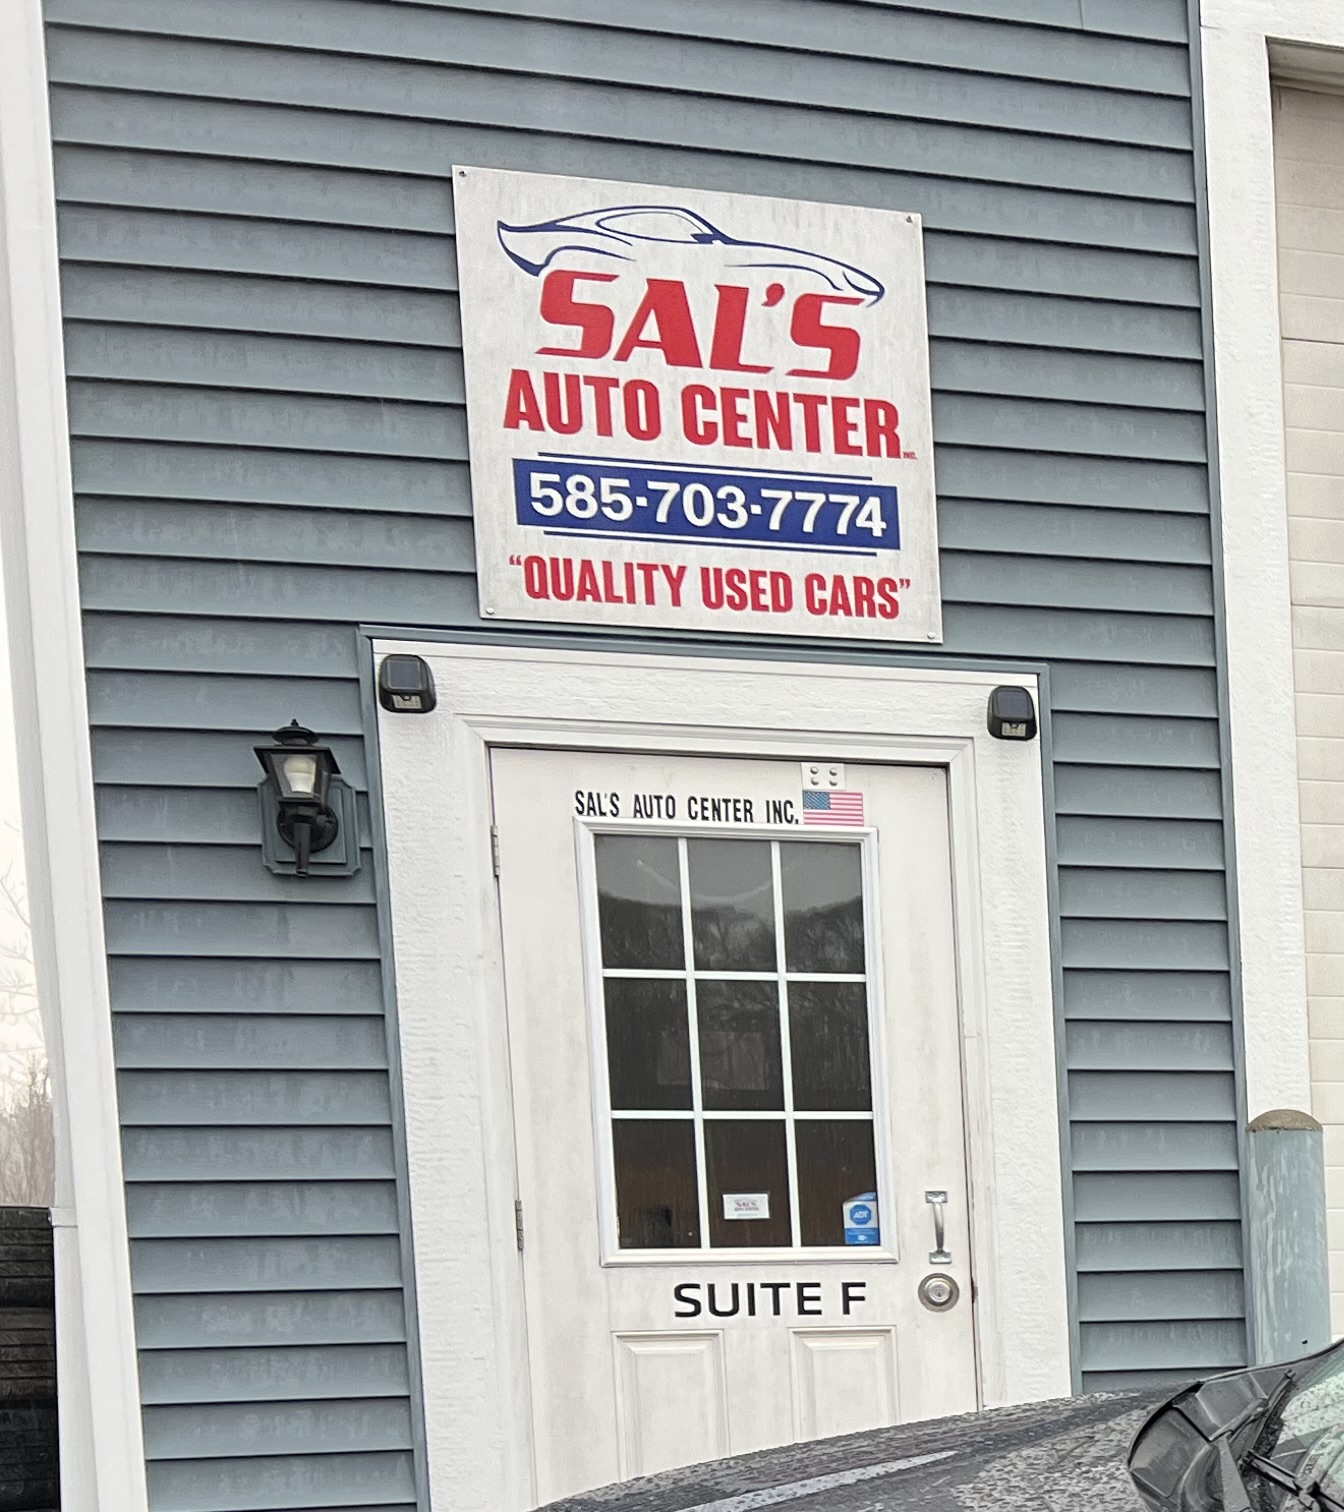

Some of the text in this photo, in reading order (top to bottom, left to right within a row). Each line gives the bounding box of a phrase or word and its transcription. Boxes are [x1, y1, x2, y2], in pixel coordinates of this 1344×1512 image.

[534, 268, 866, 381] SAL'S
[503, 368, 663, 442] AUTO
[681, 384, 902, 459] CENTER
[529, 471, 888, 537] 585-703-7774
[699, 566, 793, 614] USED
[574, 789, 800, 825] SAL'S AUTO CENTER INC.
[673, 1281, 867, 1318] SUITE F
